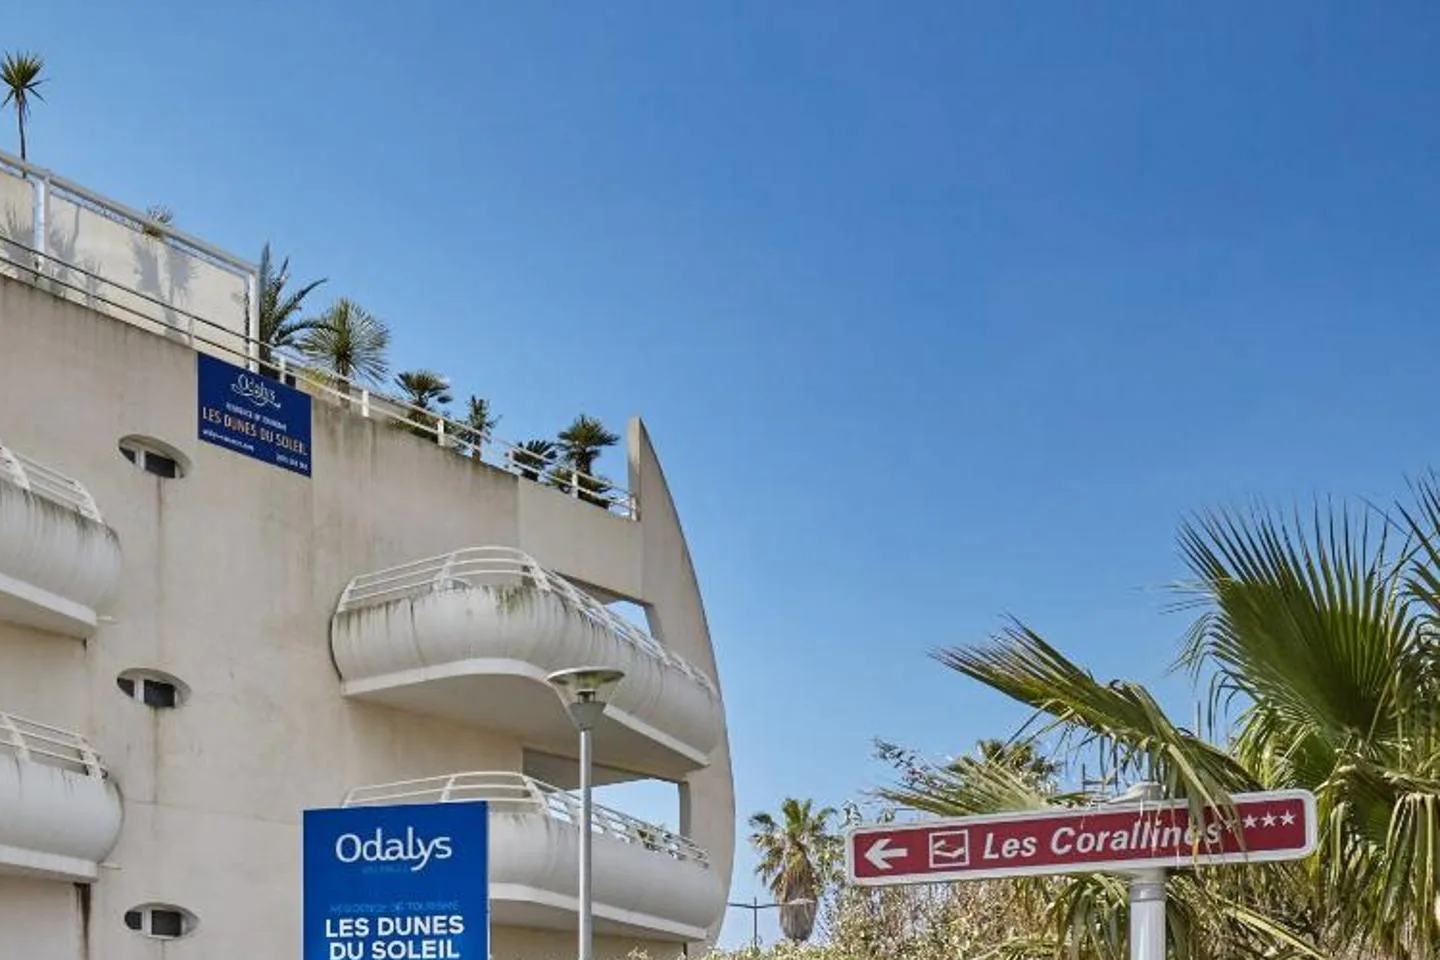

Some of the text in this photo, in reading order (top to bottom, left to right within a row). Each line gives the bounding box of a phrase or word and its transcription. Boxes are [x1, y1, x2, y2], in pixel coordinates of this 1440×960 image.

[335, 825, 453, 872] Odalys
[983, 832, 1037, 862] Les
[325, 915, 465, 938] LES DUNES
[372, 939, 461, 960] SOLEIL
